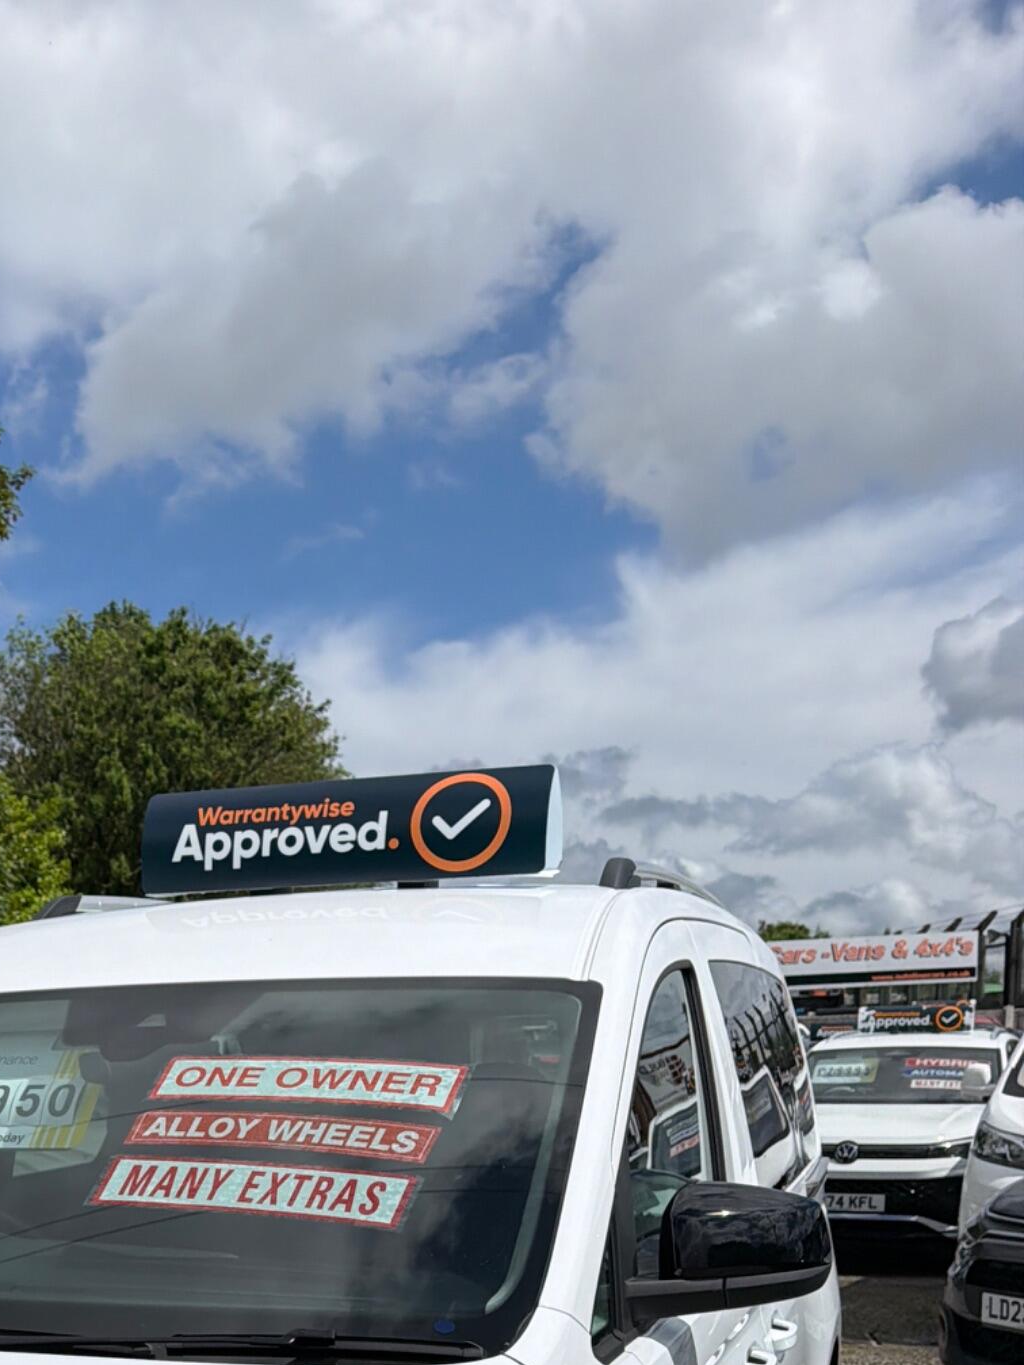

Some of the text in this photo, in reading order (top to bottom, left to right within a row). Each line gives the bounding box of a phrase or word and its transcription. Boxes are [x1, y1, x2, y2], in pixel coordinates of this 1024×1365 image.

[197, 798, 356, 828] Warrantywise
[171, 810, 400, 872] Approved.
[891, 939, 908, 960] &
[174, 1066, 443, 1098] ONE OWNER
[142, 1116, 420, 1154] ALLOY WHEELS
[117, 1164, 387, 1217] MANY EXTRAS
[848, 1196, 877, 1209] KFL
[988, 1295, 1024, 1324] LD2
